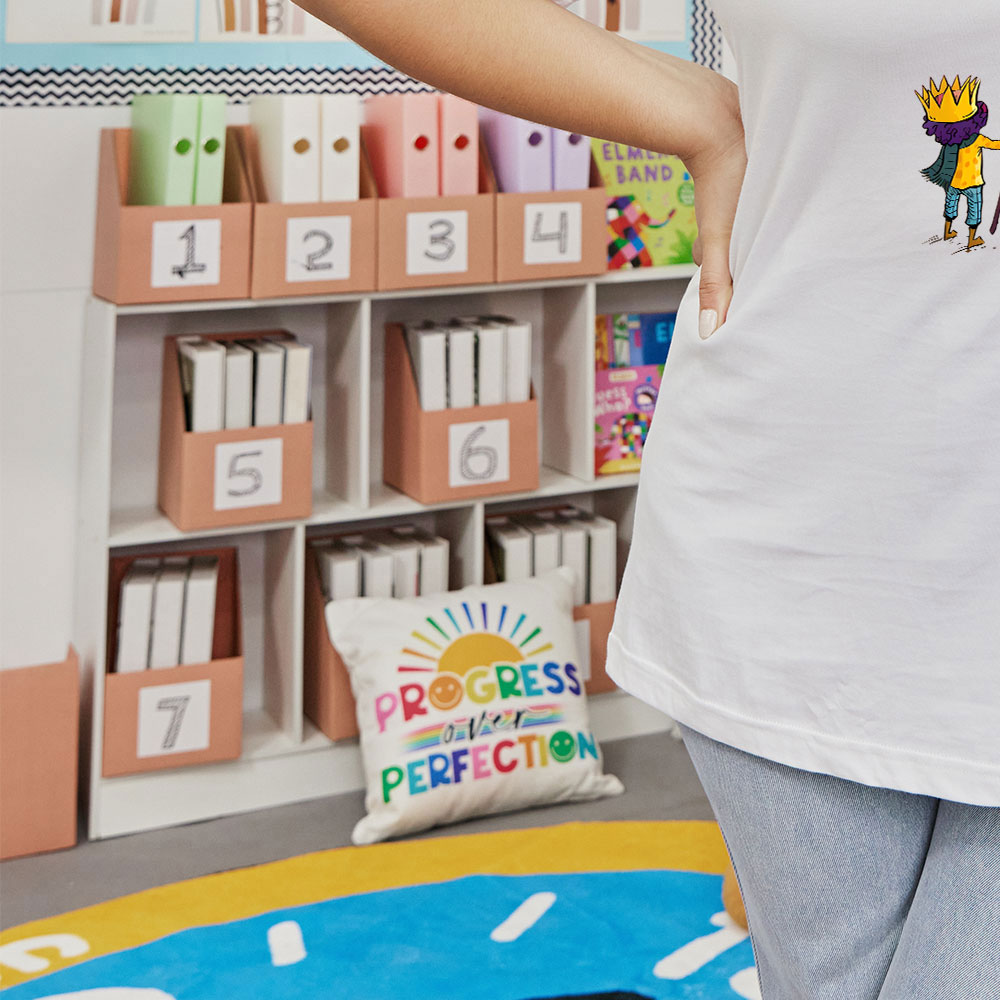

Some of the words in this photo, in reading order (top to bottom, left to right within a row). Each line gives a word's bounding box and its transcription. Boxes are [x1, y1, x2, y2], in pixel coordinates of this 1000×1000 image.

[616, 164, 673, 184] BAND
[172, 224, 206, 278] 1
[300, 229, 333, 270] 2
[424, 219, 456, 261] 3
[531, 211, 567, 253] 4
[227, 450, 263, 498] 5
[459, 426, 497, 481] 6
[375, 661, 582, 733] PROGRESS
[157, 696, 191, 750] 7
[442, 708, 528, 746] over
[381, 730, 599, 804] PERFECTION
